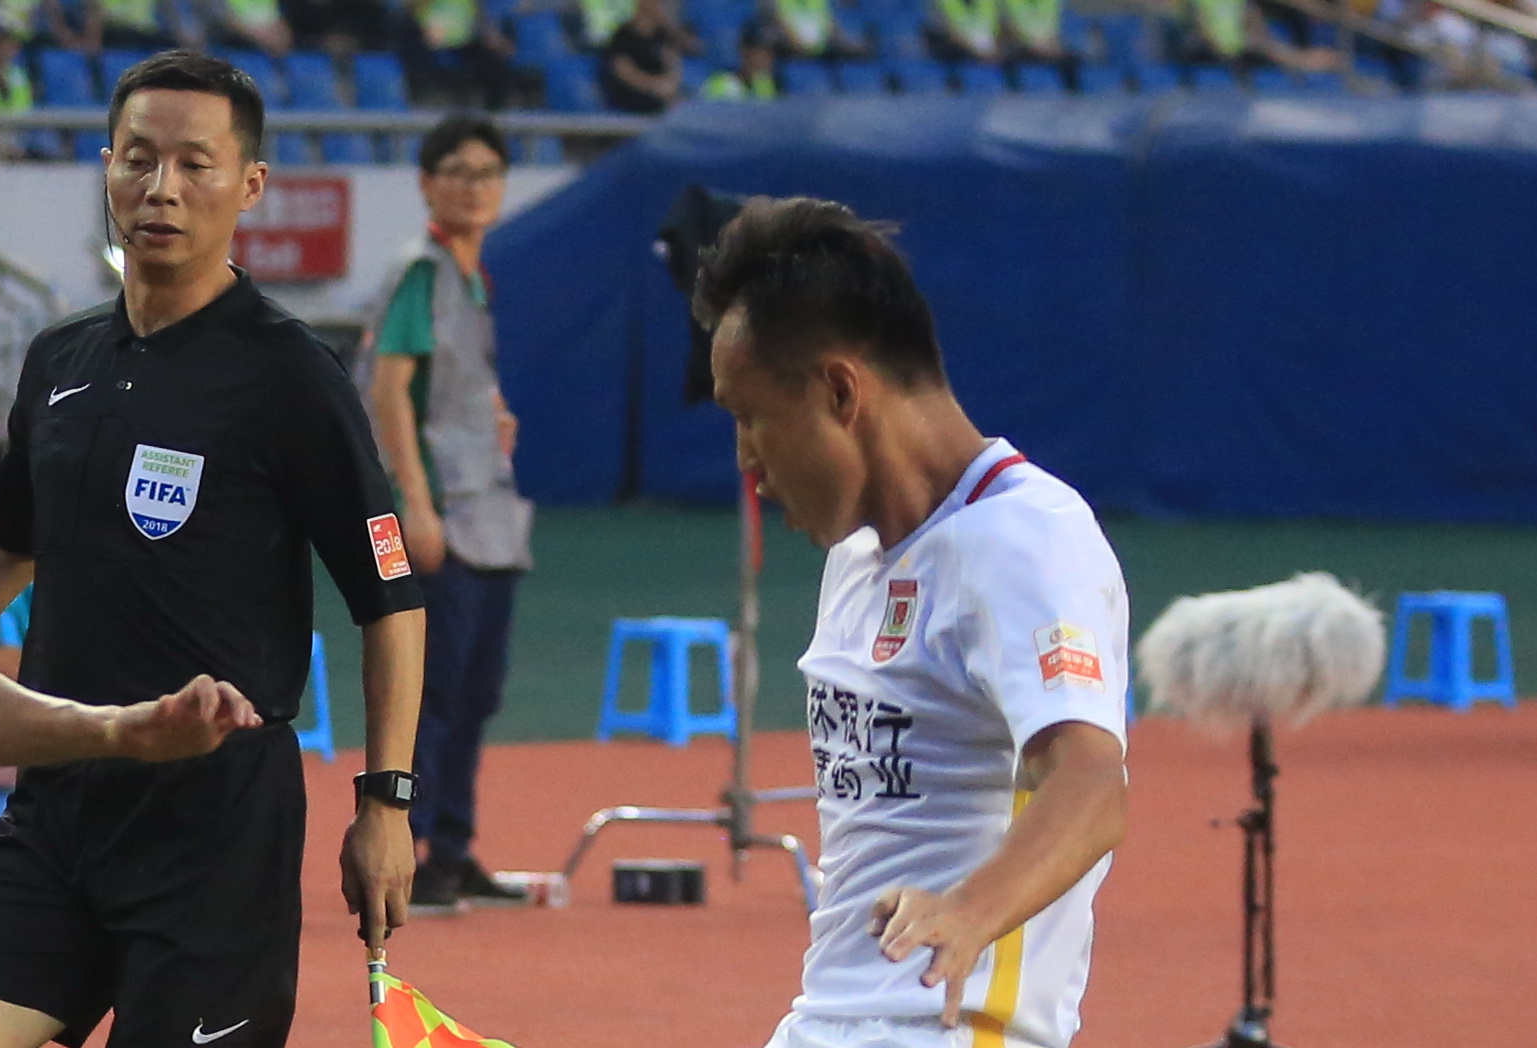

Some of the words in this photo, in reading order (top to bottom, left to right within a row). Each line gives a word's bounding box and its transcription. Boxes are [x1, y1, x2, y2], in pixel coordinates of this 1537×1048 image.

[142, 450, 197, 468] ASSISTANT
[143, 461, 189, 478] REFEREE
[142, 519, 169, 533] 2018
[375, 530, 403, 556] 2018
